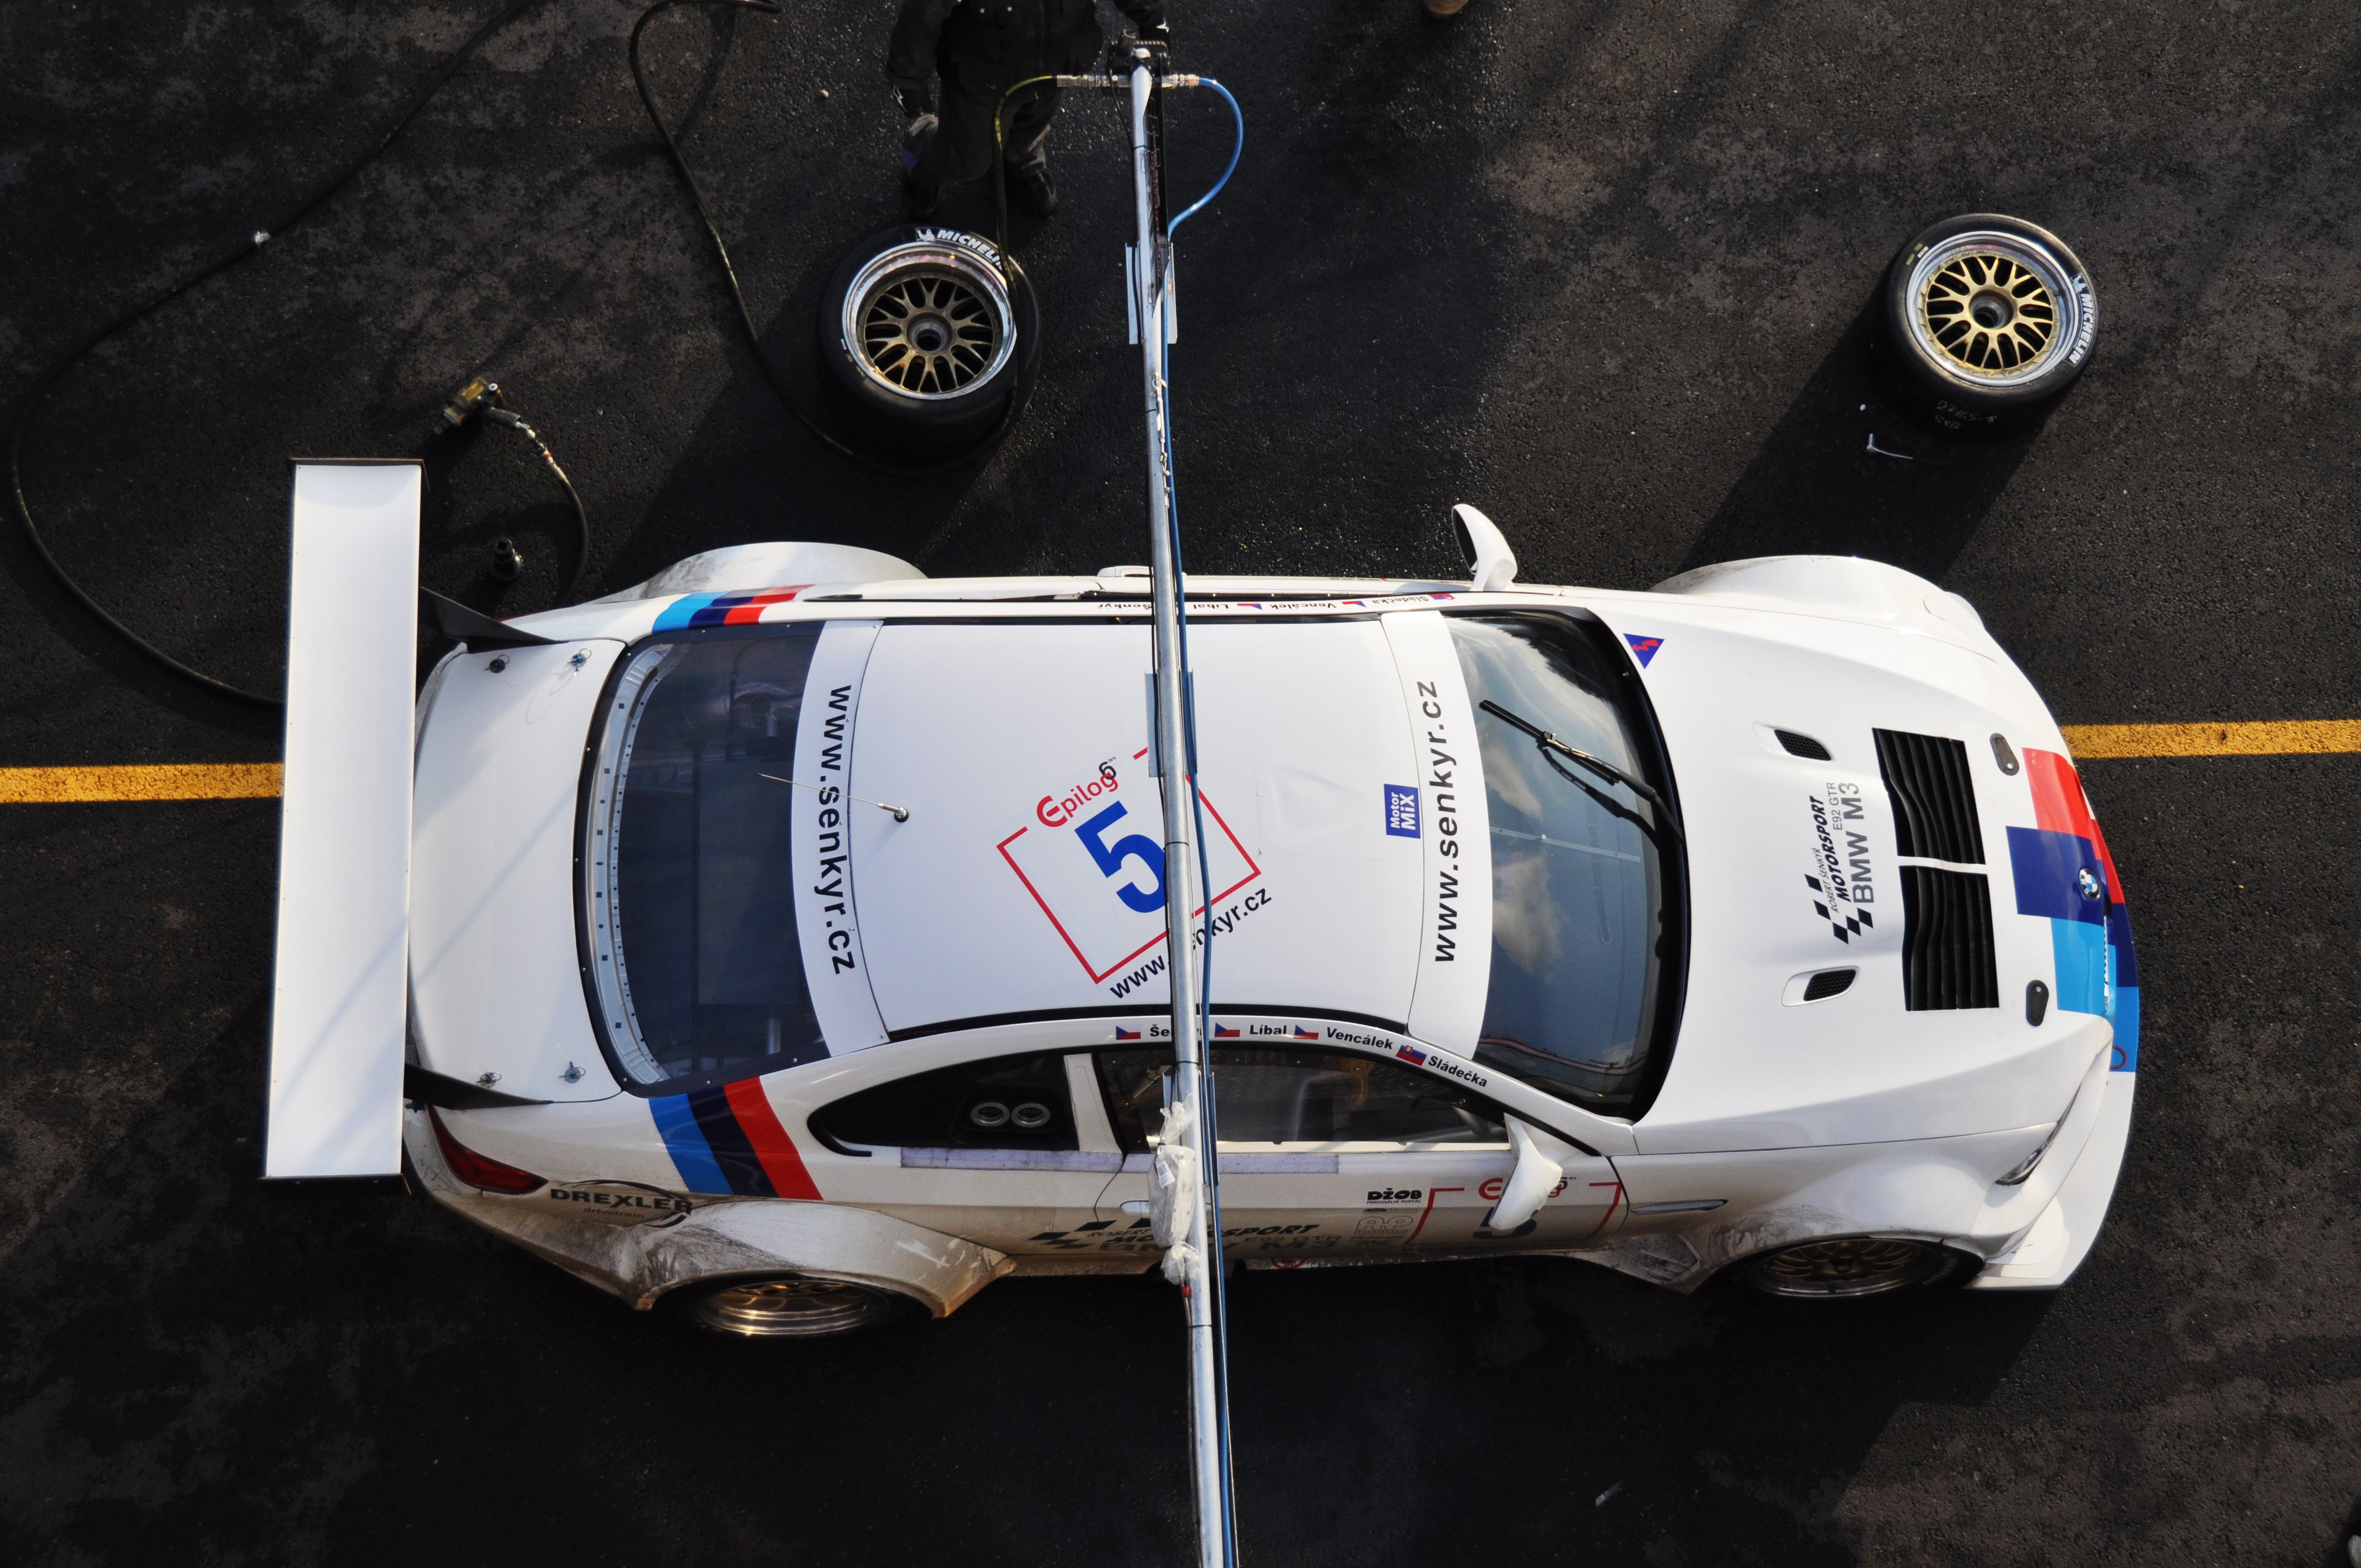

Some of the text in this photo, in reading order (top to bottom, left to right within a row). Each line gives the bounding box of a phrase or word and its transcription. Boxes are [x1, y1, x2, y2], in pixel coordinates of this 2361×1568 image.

[2069, 293, 2093, 364] MICHELIN
[814, 685, 855, 974] www.senkyr.cz
[1036, 771, 1119, 827] Epilog
[1391, 792, 1399, 829] Motor
[1417, 681, 1459, 962] www.senkyr.cz
[1826, 782, 1843, 830] E92 GTR
[1074, 800, 1168, 913] 5
[1809, 794, 1851, 902] MOTORSPORT
[1838, 782, 1874, 903] BMW M3
[1823, 880, 1839, 913] ROBERT
[1109, 888, 1271, 999] www.nkyr.cz
[1249, 1023, 1487, 1087] Líbal Vencálek Sládečka
[551, 1188, 693, 1211] DREXLER
[1367, 1188, 1422, 1200] DŽOB
